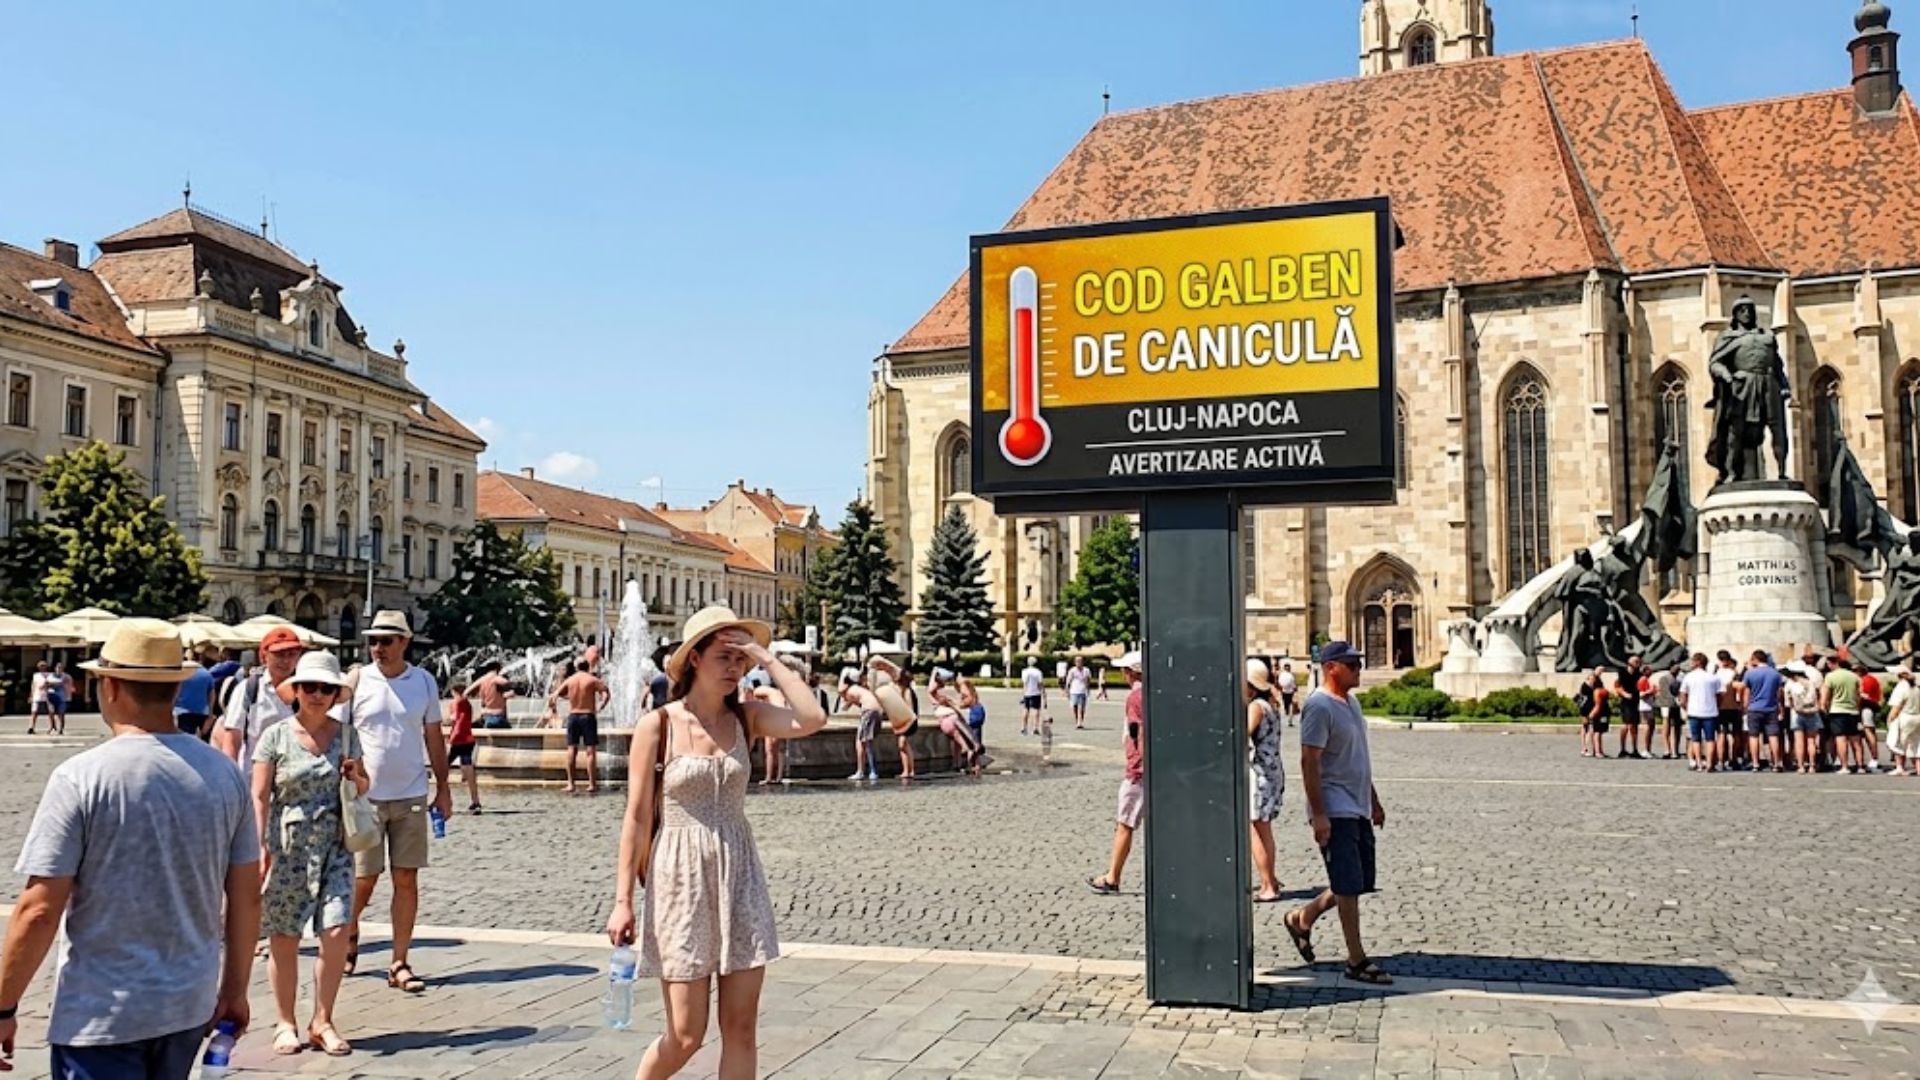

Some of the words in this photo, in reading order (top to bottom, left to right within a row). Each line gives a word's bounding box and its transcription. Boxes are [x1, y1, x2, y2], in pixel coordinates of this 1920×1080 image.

[1075, 269, 1164, 315] COD
[1181, 249, 1361, 308] GALBEN
[1074, 333, 1126, 376] DE
[1139, 305, 1361, 373] CANICULĂ
[1127, 400, 1300, 433] CLUJ-NAPOCA
[1108, 447, 1238, 476] AVERTIZARE
[1243, 439, 1325, 469] ACTIVĂ
[1737, 560, 1797, 570] MATTHIAS
